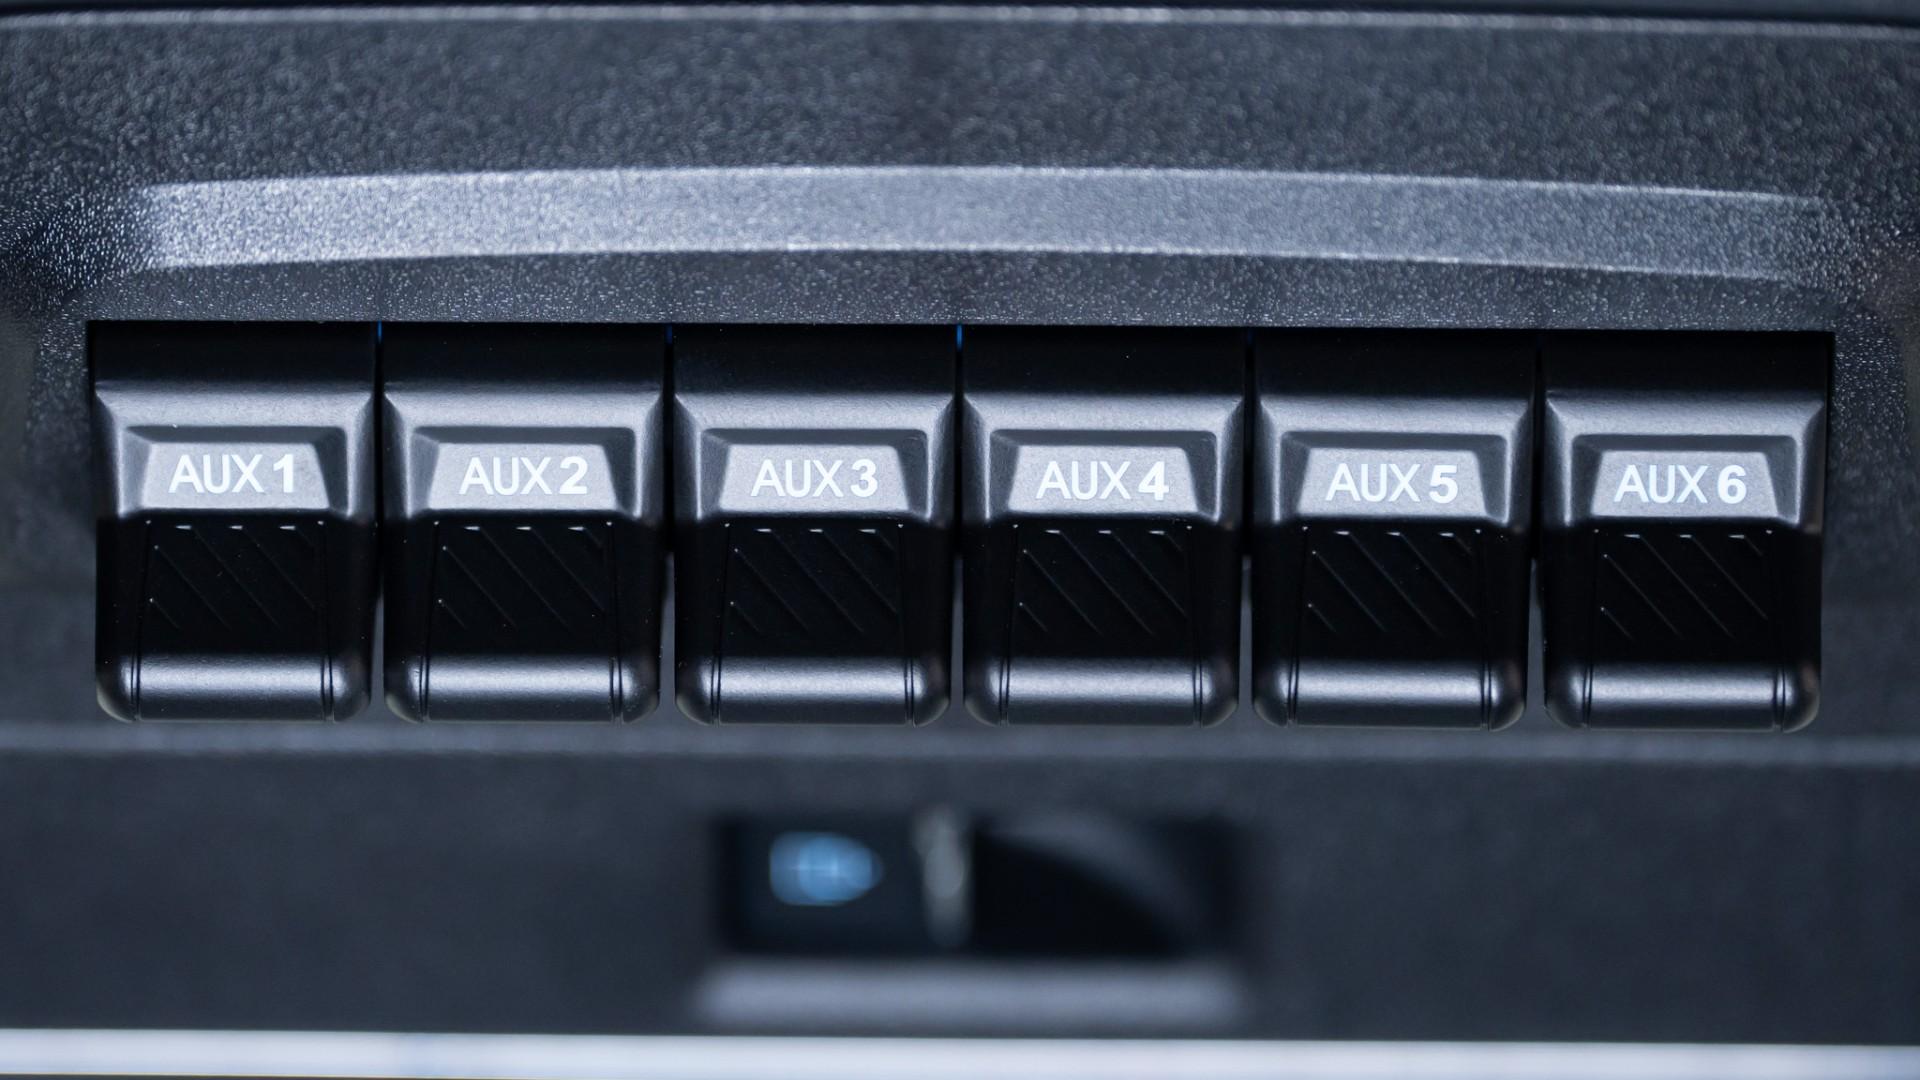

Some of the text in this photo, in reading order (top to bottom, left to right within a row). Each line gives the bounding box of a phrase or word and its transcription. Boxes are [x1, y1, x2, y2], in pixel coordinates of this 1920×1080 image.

[168, 453, 295, 493] AUX 1
[458, 455, 588, 495] AUX 2
[750, 458, 878, 498] AUX 3
[1035, 460, 1170, 501] AUX 4
[1325, 463, 1459, 504] AUX 5
[1614, 464, 1747, 504] AUX 6
